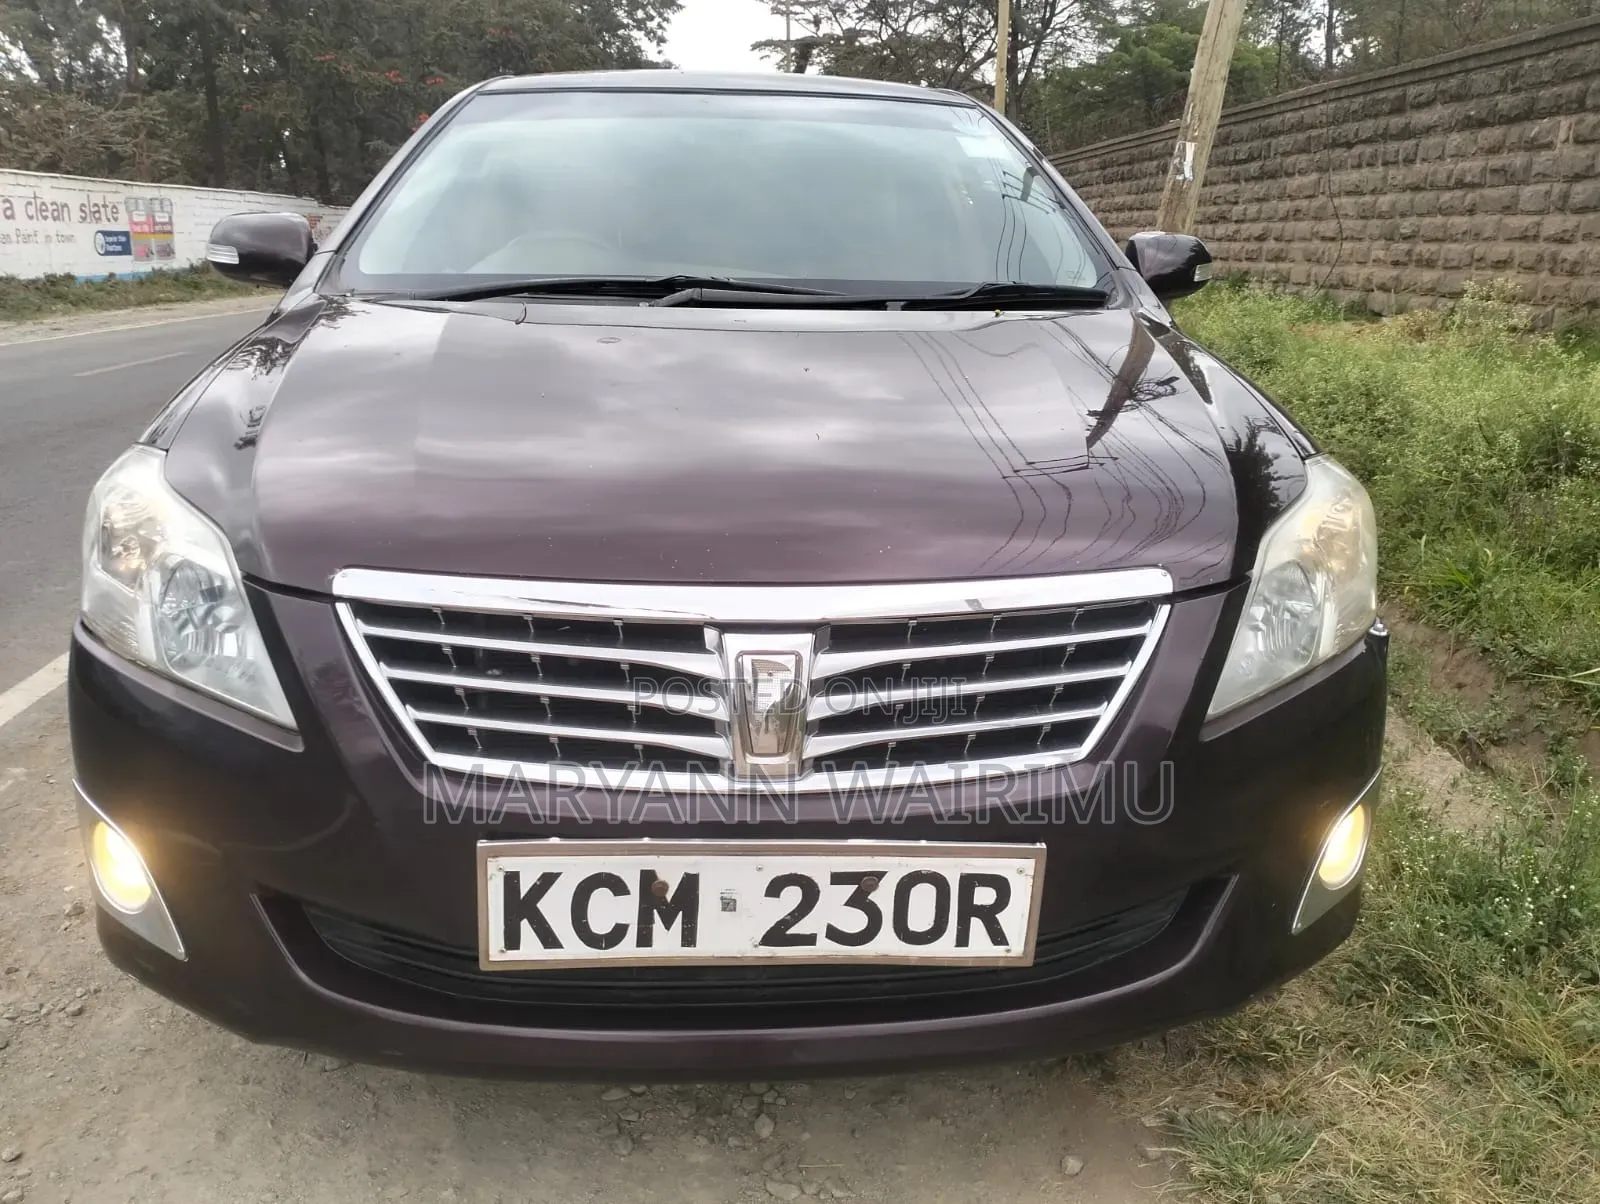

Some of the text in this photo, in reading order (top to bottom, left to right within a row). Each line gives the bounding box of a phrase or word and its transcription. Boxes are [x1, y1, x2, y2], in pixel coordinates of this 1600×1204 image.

[2, 191, 119, 222] a clean slate
[503, 868, 1012, 950] KCM 230R
